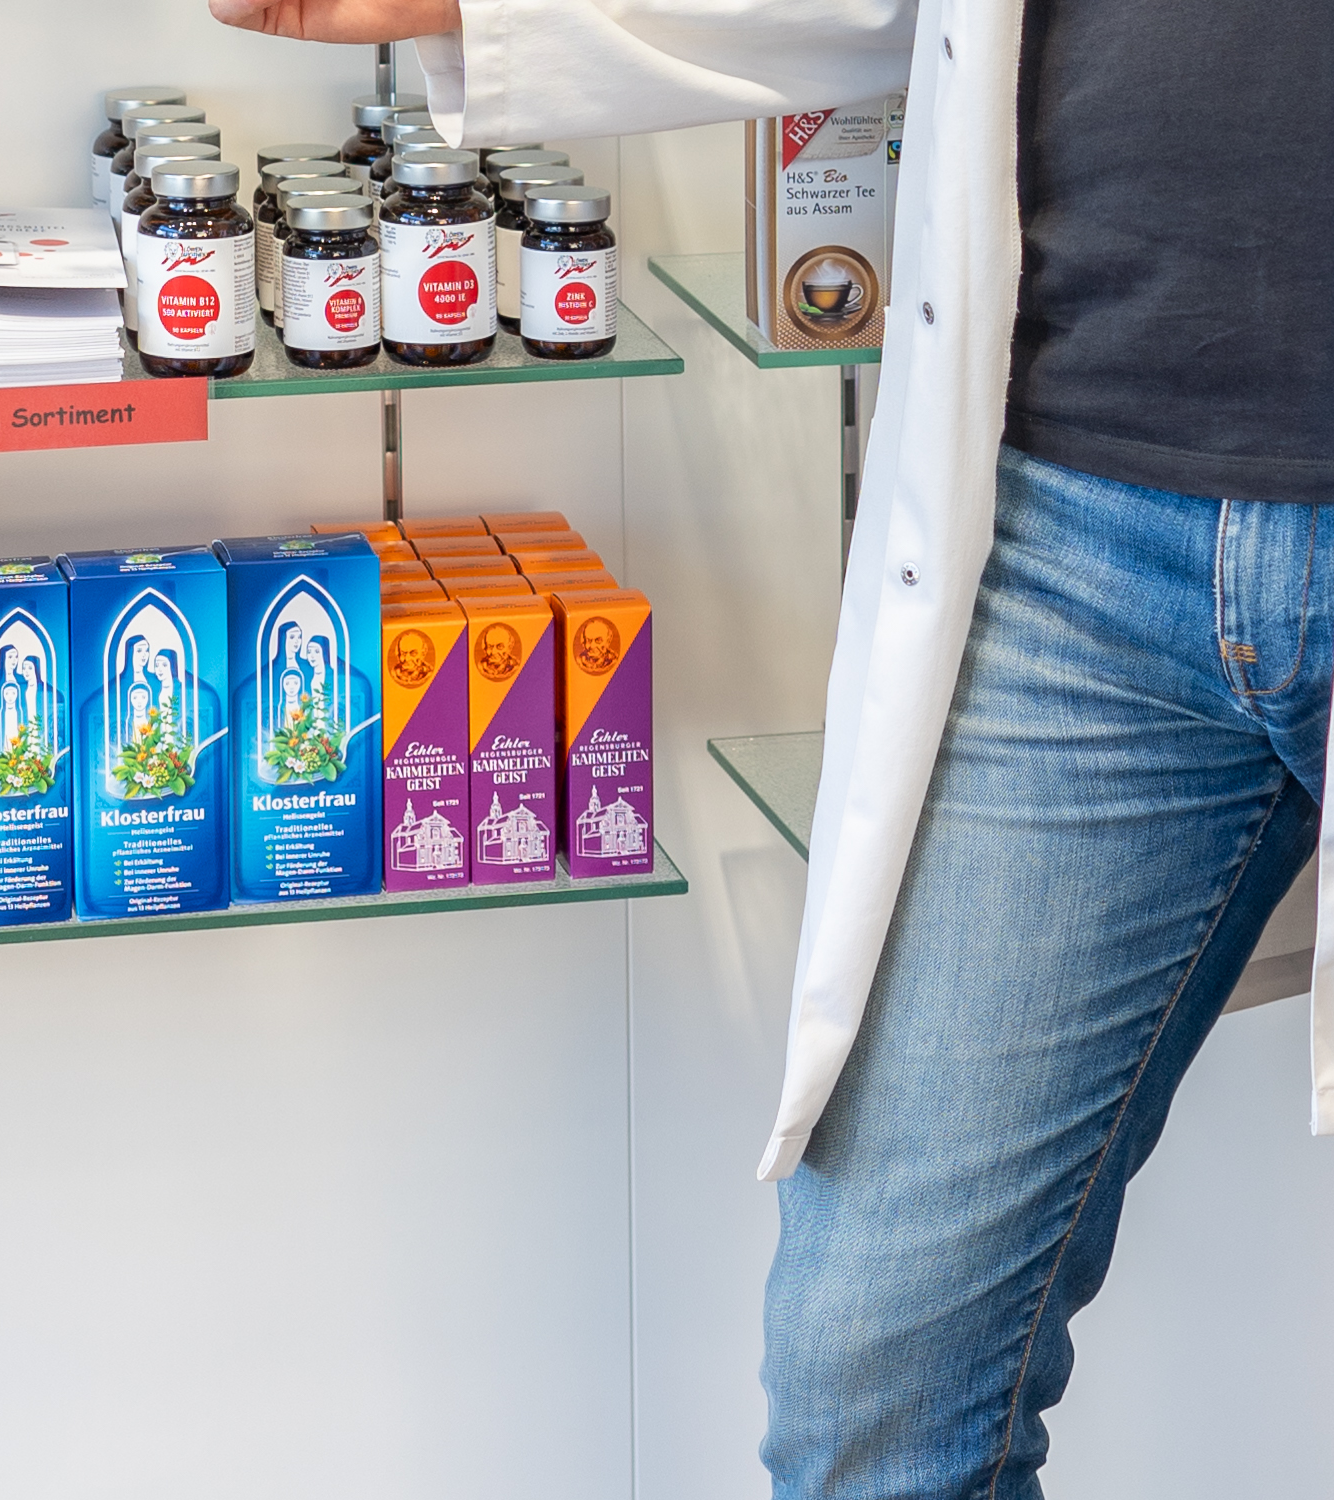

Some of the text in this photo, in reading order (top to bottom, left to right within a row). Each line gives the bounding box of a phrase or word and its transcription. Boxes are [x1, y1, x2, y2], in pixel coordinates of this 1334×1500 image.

[830, 116, 883, 125] Wohlfühltee
[787, 169, 848, 184] H&S Bio
[787, 186, 875, 200] Schwarzer Tee
[787, 203, 852, 215] aus Assam
[423, 280, 461, 293] VITAMIN
[12, 404, 136, 428] Sortiment
[386, 763, 464, 780] KARMELITEN
[407, 778, 441, 791] GEIST
[253, 791, 356, 811] Klosterfrau
[101, 807, 204, 827] Klosterfrau
